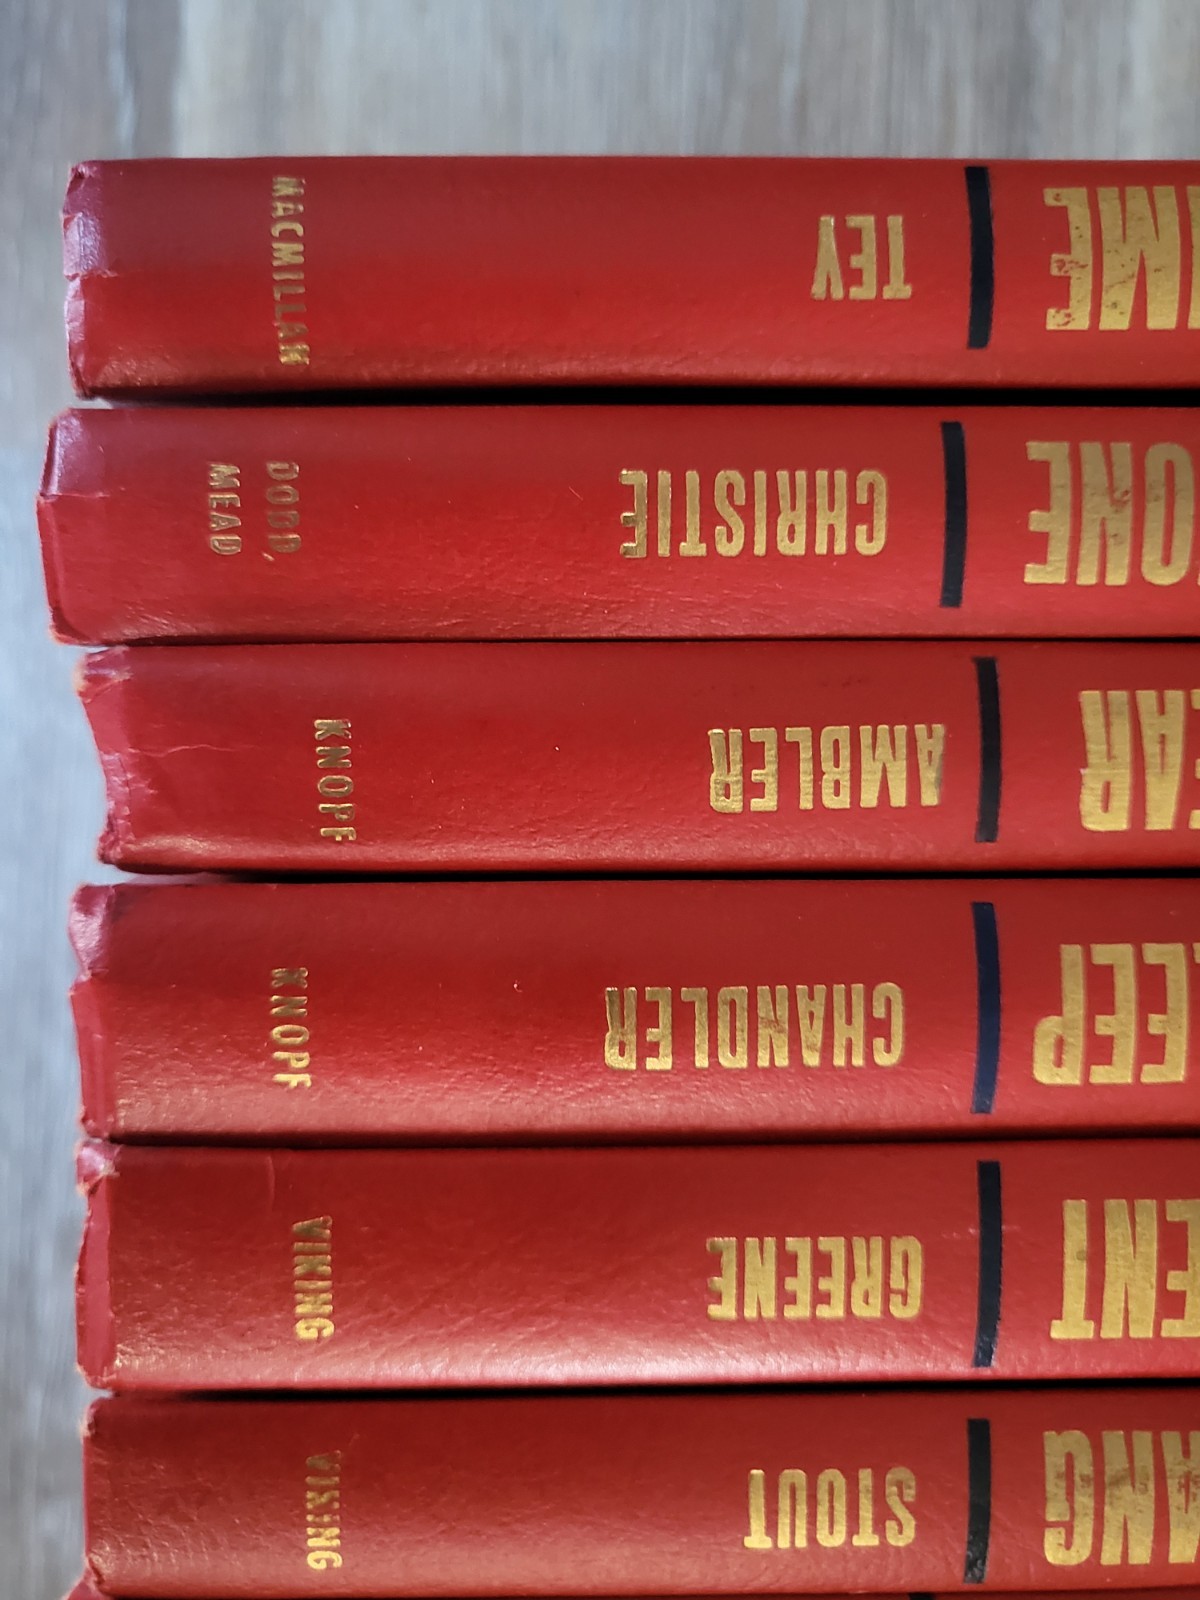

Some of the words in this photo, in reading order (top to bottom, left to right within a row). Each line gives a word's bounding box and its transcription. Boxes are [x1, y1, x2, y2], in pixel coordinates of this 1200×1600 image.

[271, 176, 310, 365] MACMILLAN
[810, 214, 912, 300] TEY
[208, 463, 242, 555] MEAD
[262, 461, 301, 561] DODD,
[619, 468, 887, 558] CHRISTIE
[1023, 441, 1200, 586] ONE
[314, 718, 356, 841] KNOPF
[707, 724, 946, 813] AMBLER
[1079, 689, 1200, 832] AR
[270, 967, 311, 1089] KNOPF
[604, 982, 904, 1070] CHANDLER
[1032, 943, 1200, 1086] EEP
[292, 1215, 334, 1340] VIKING
[706, 1236, 923, 1320] GREENE
[305, 1450, 342, 1570] VIKING
[743, 1468, 916, 1549] STOUT
